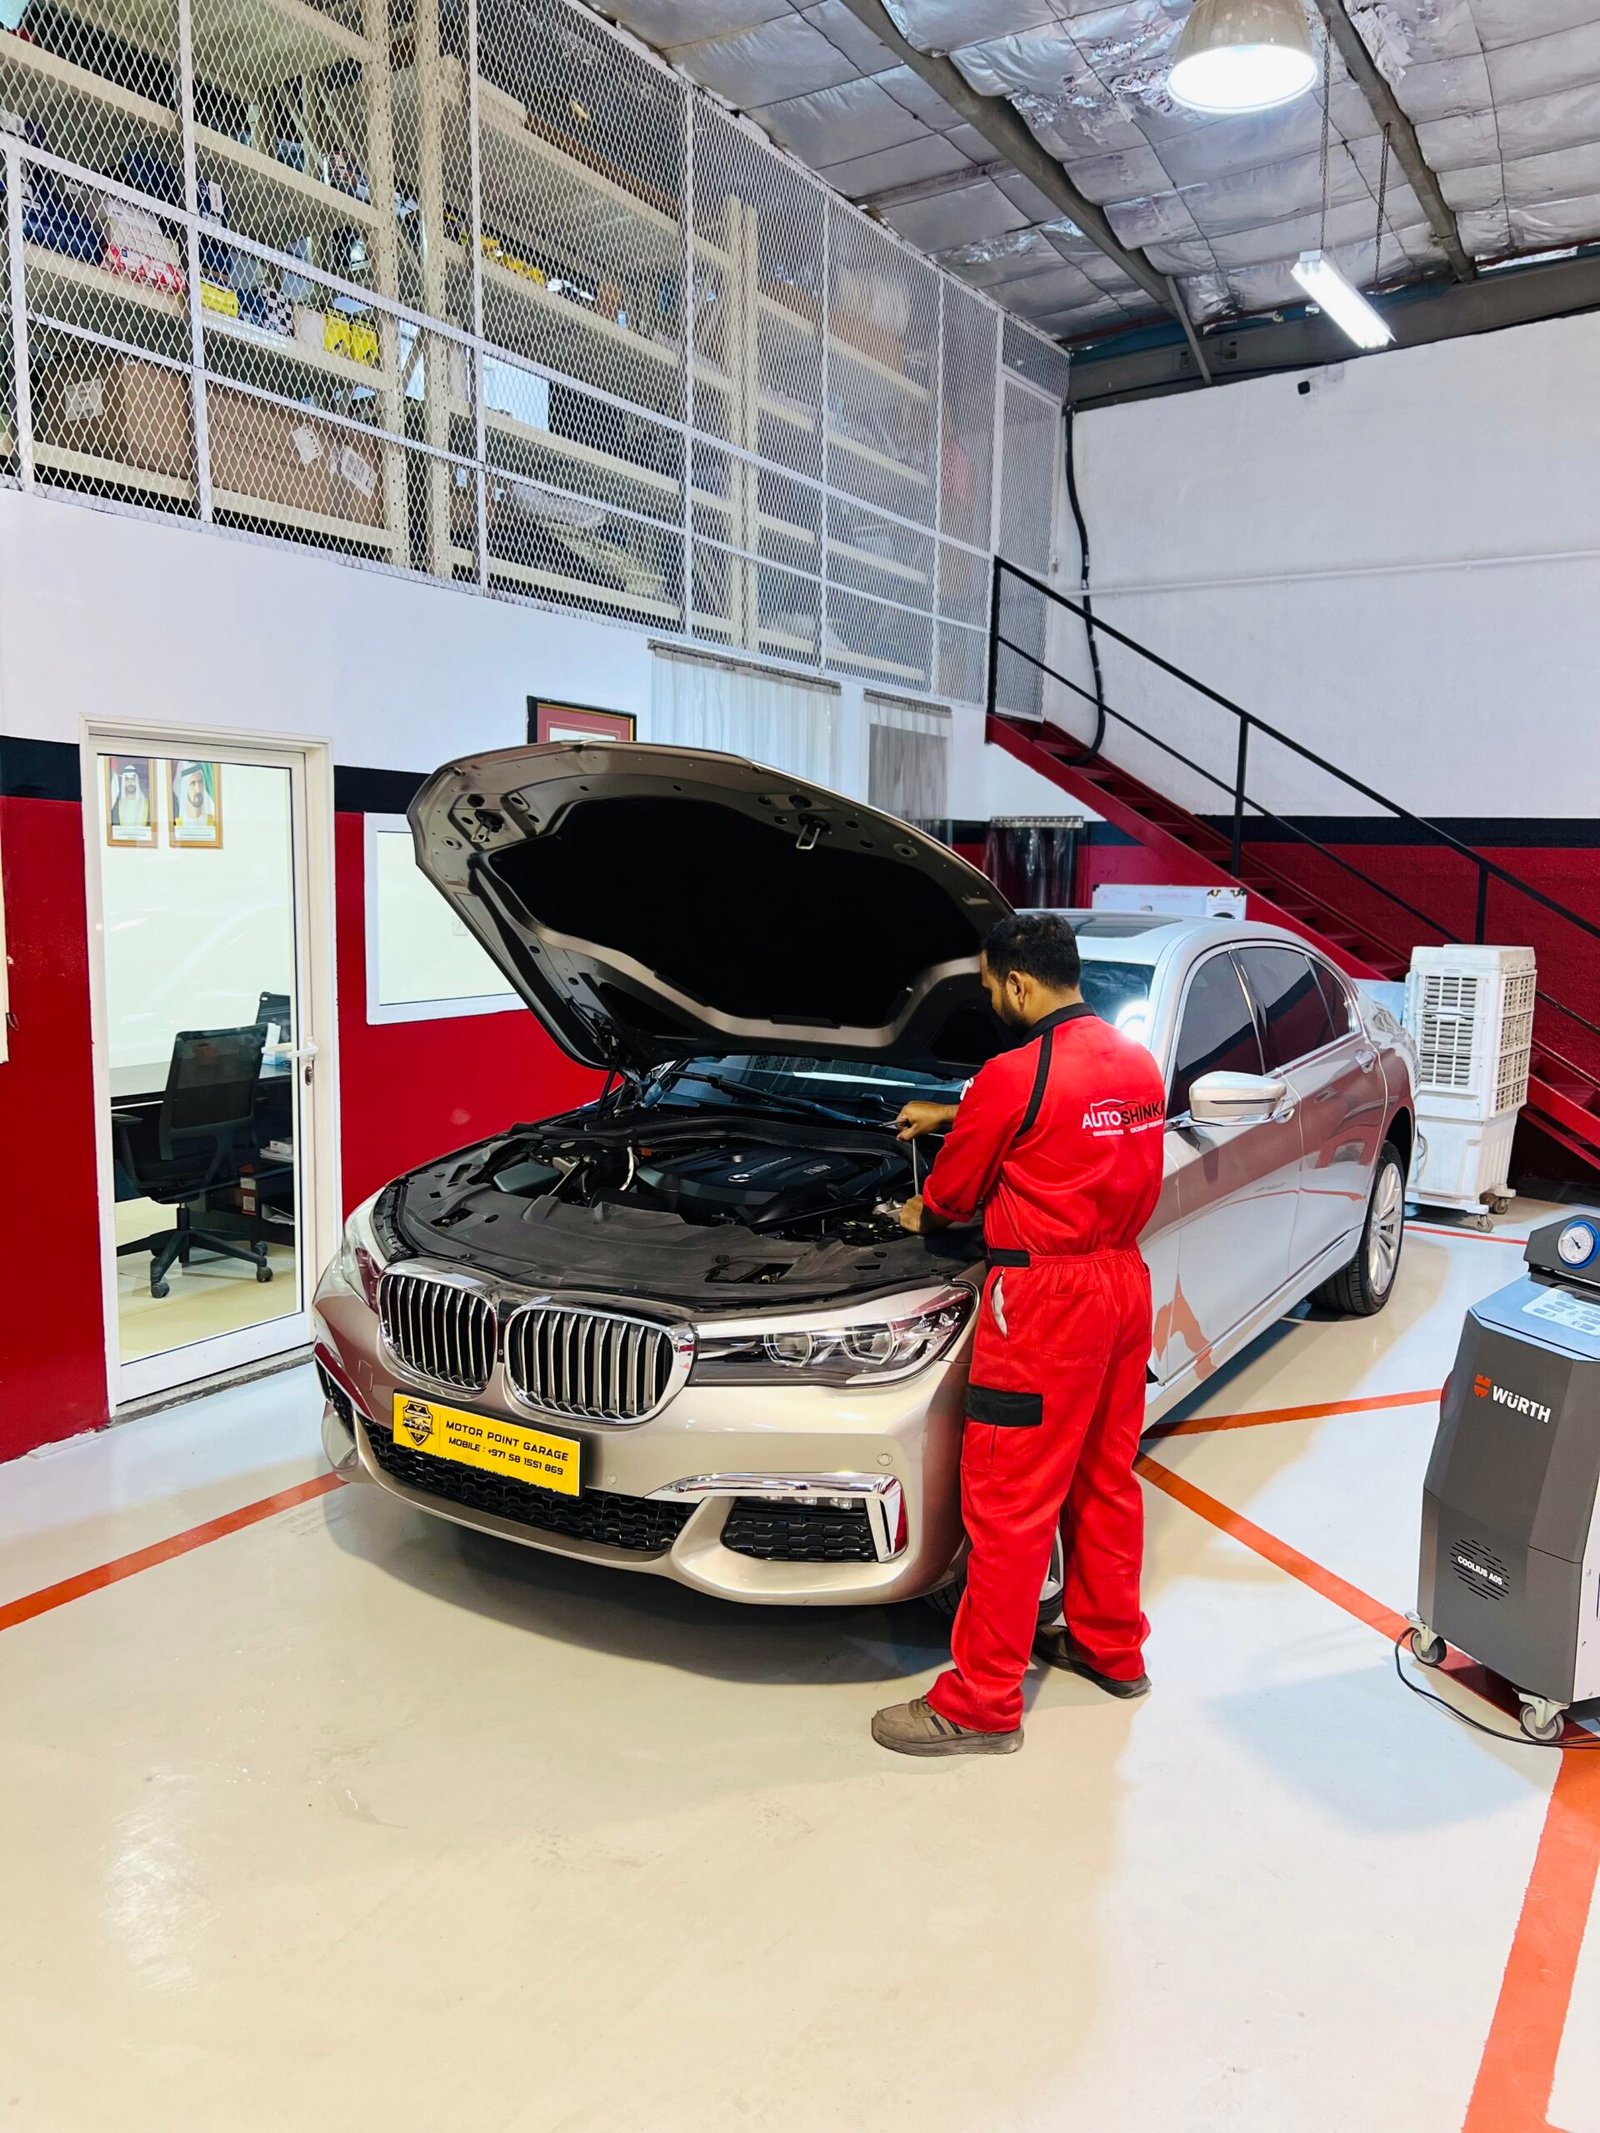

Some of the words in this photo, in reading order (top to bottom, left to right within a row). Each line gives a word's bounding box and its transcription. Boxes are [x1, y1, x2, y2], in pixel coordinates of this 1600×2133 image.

[1492, 1384, 1552, 1424] WÜRTH
[446, 1420, 483, 1438] MOTOR
[487, 1431, 520, 1448] POINT
[523, 1441, 569, 1462] GARAGE
[448, 1436, 481, 1452] MOBILE
[488, 1448, 506, 1459] +971
[508, 1453, 521, 1463] 58
[524, 1457, 542, 1470] 1551
[544, 1463, 564, 1476] 869
[1457, 1555, 1488, 1578] COOLIUS
